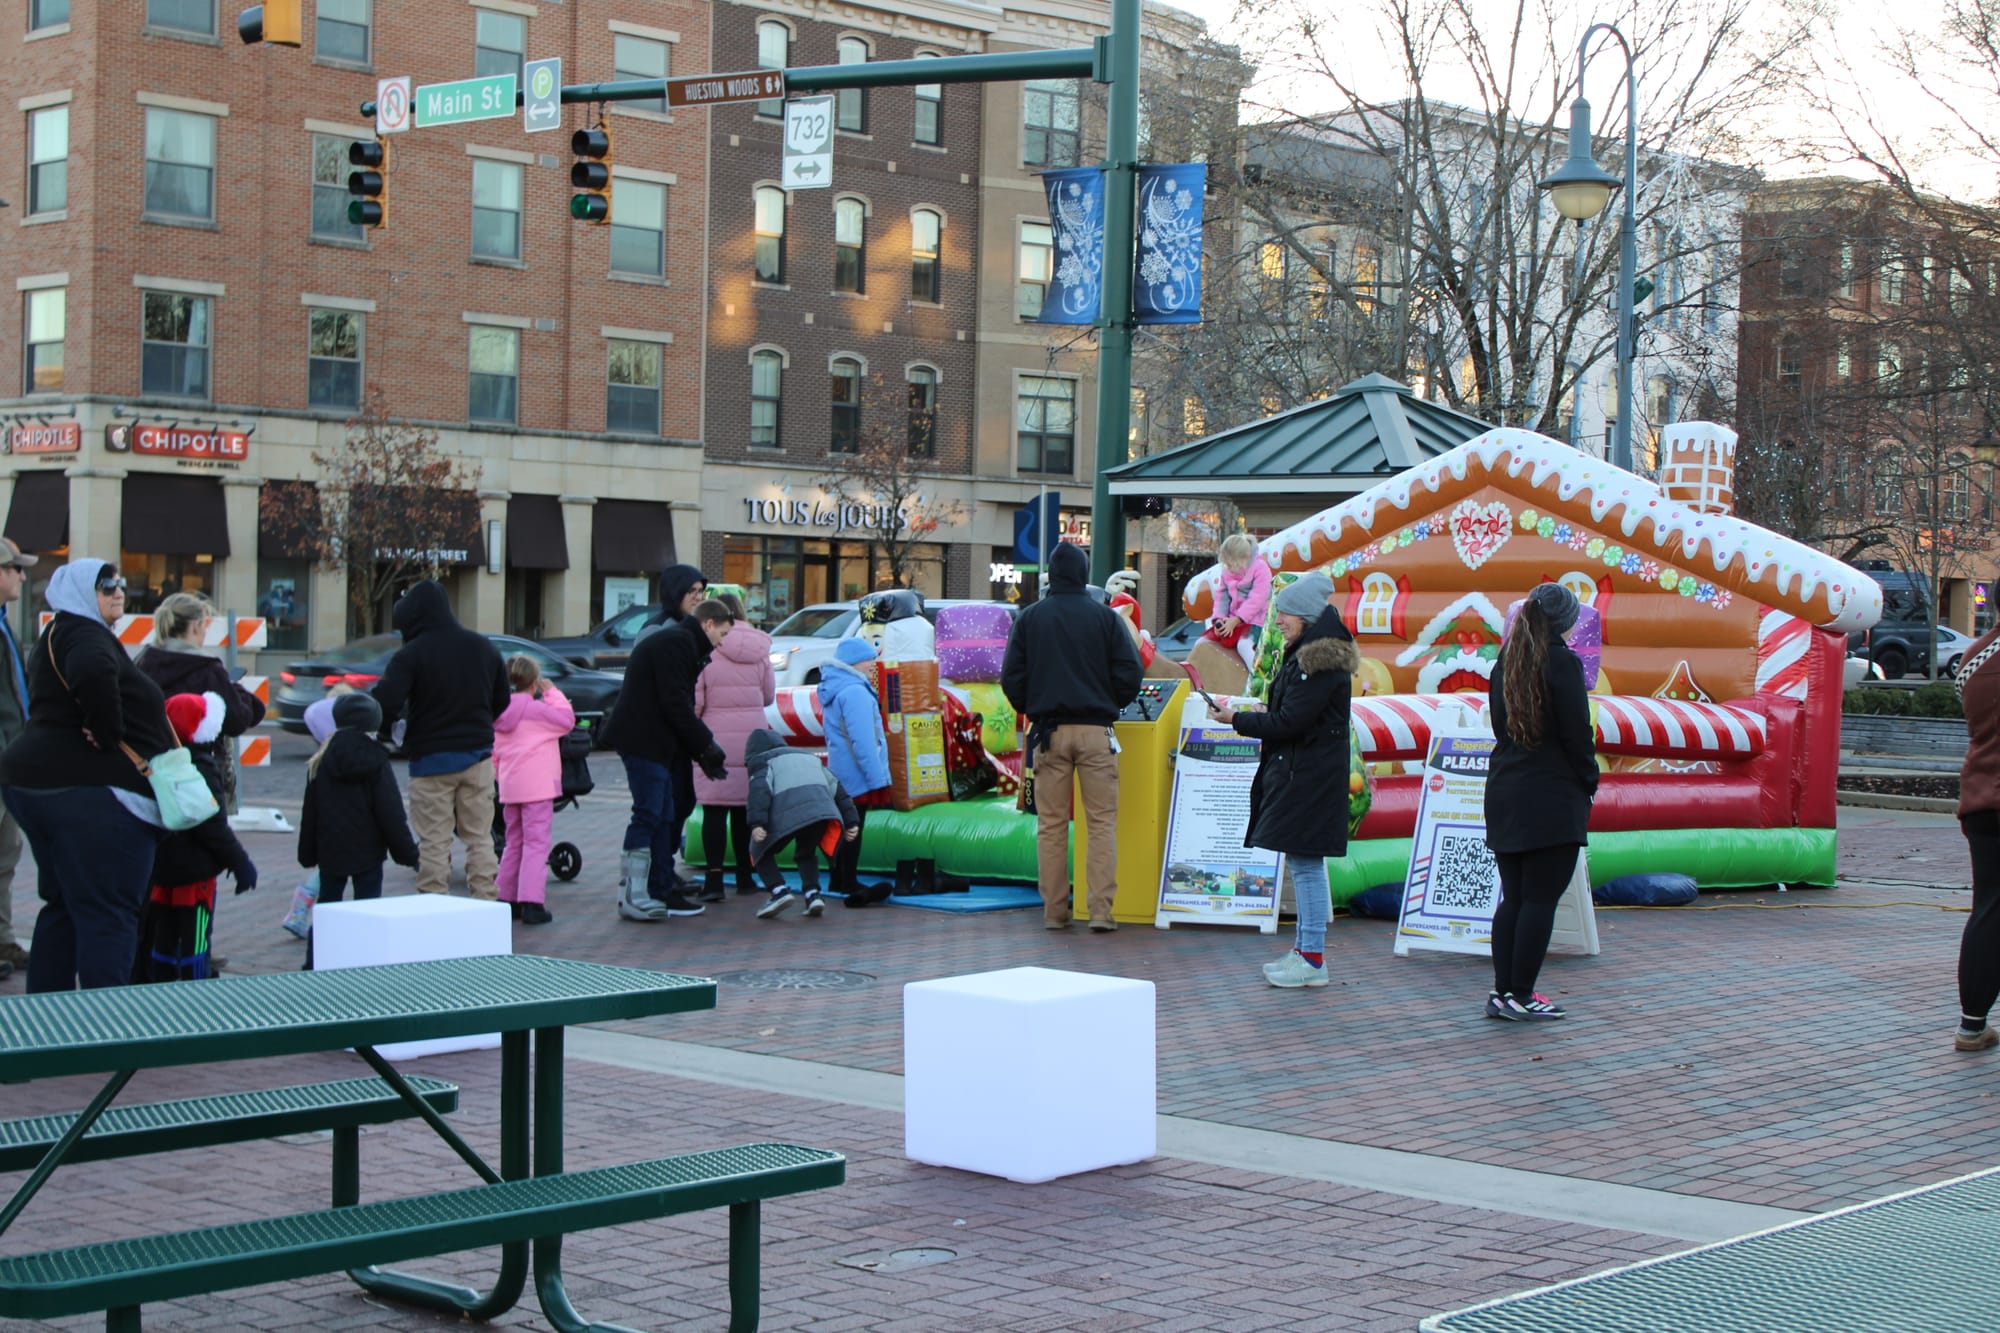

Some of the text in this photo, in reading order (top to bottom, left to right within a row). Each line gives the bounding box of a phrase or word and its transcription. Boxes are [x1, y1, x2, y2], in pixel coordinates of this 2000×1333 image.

[428, 85, 502, 118] Main St
[685, 76, 773, 101] HUESTON WOODS 6
[791, 114, 825, 141] 732
[13, 428, 74, 448] CHIPOTLE
[139, 431, 244, 454] CHIPOTLE
[744, 497, 811, 527] TOUS
[814, 501, 837, 527] les
